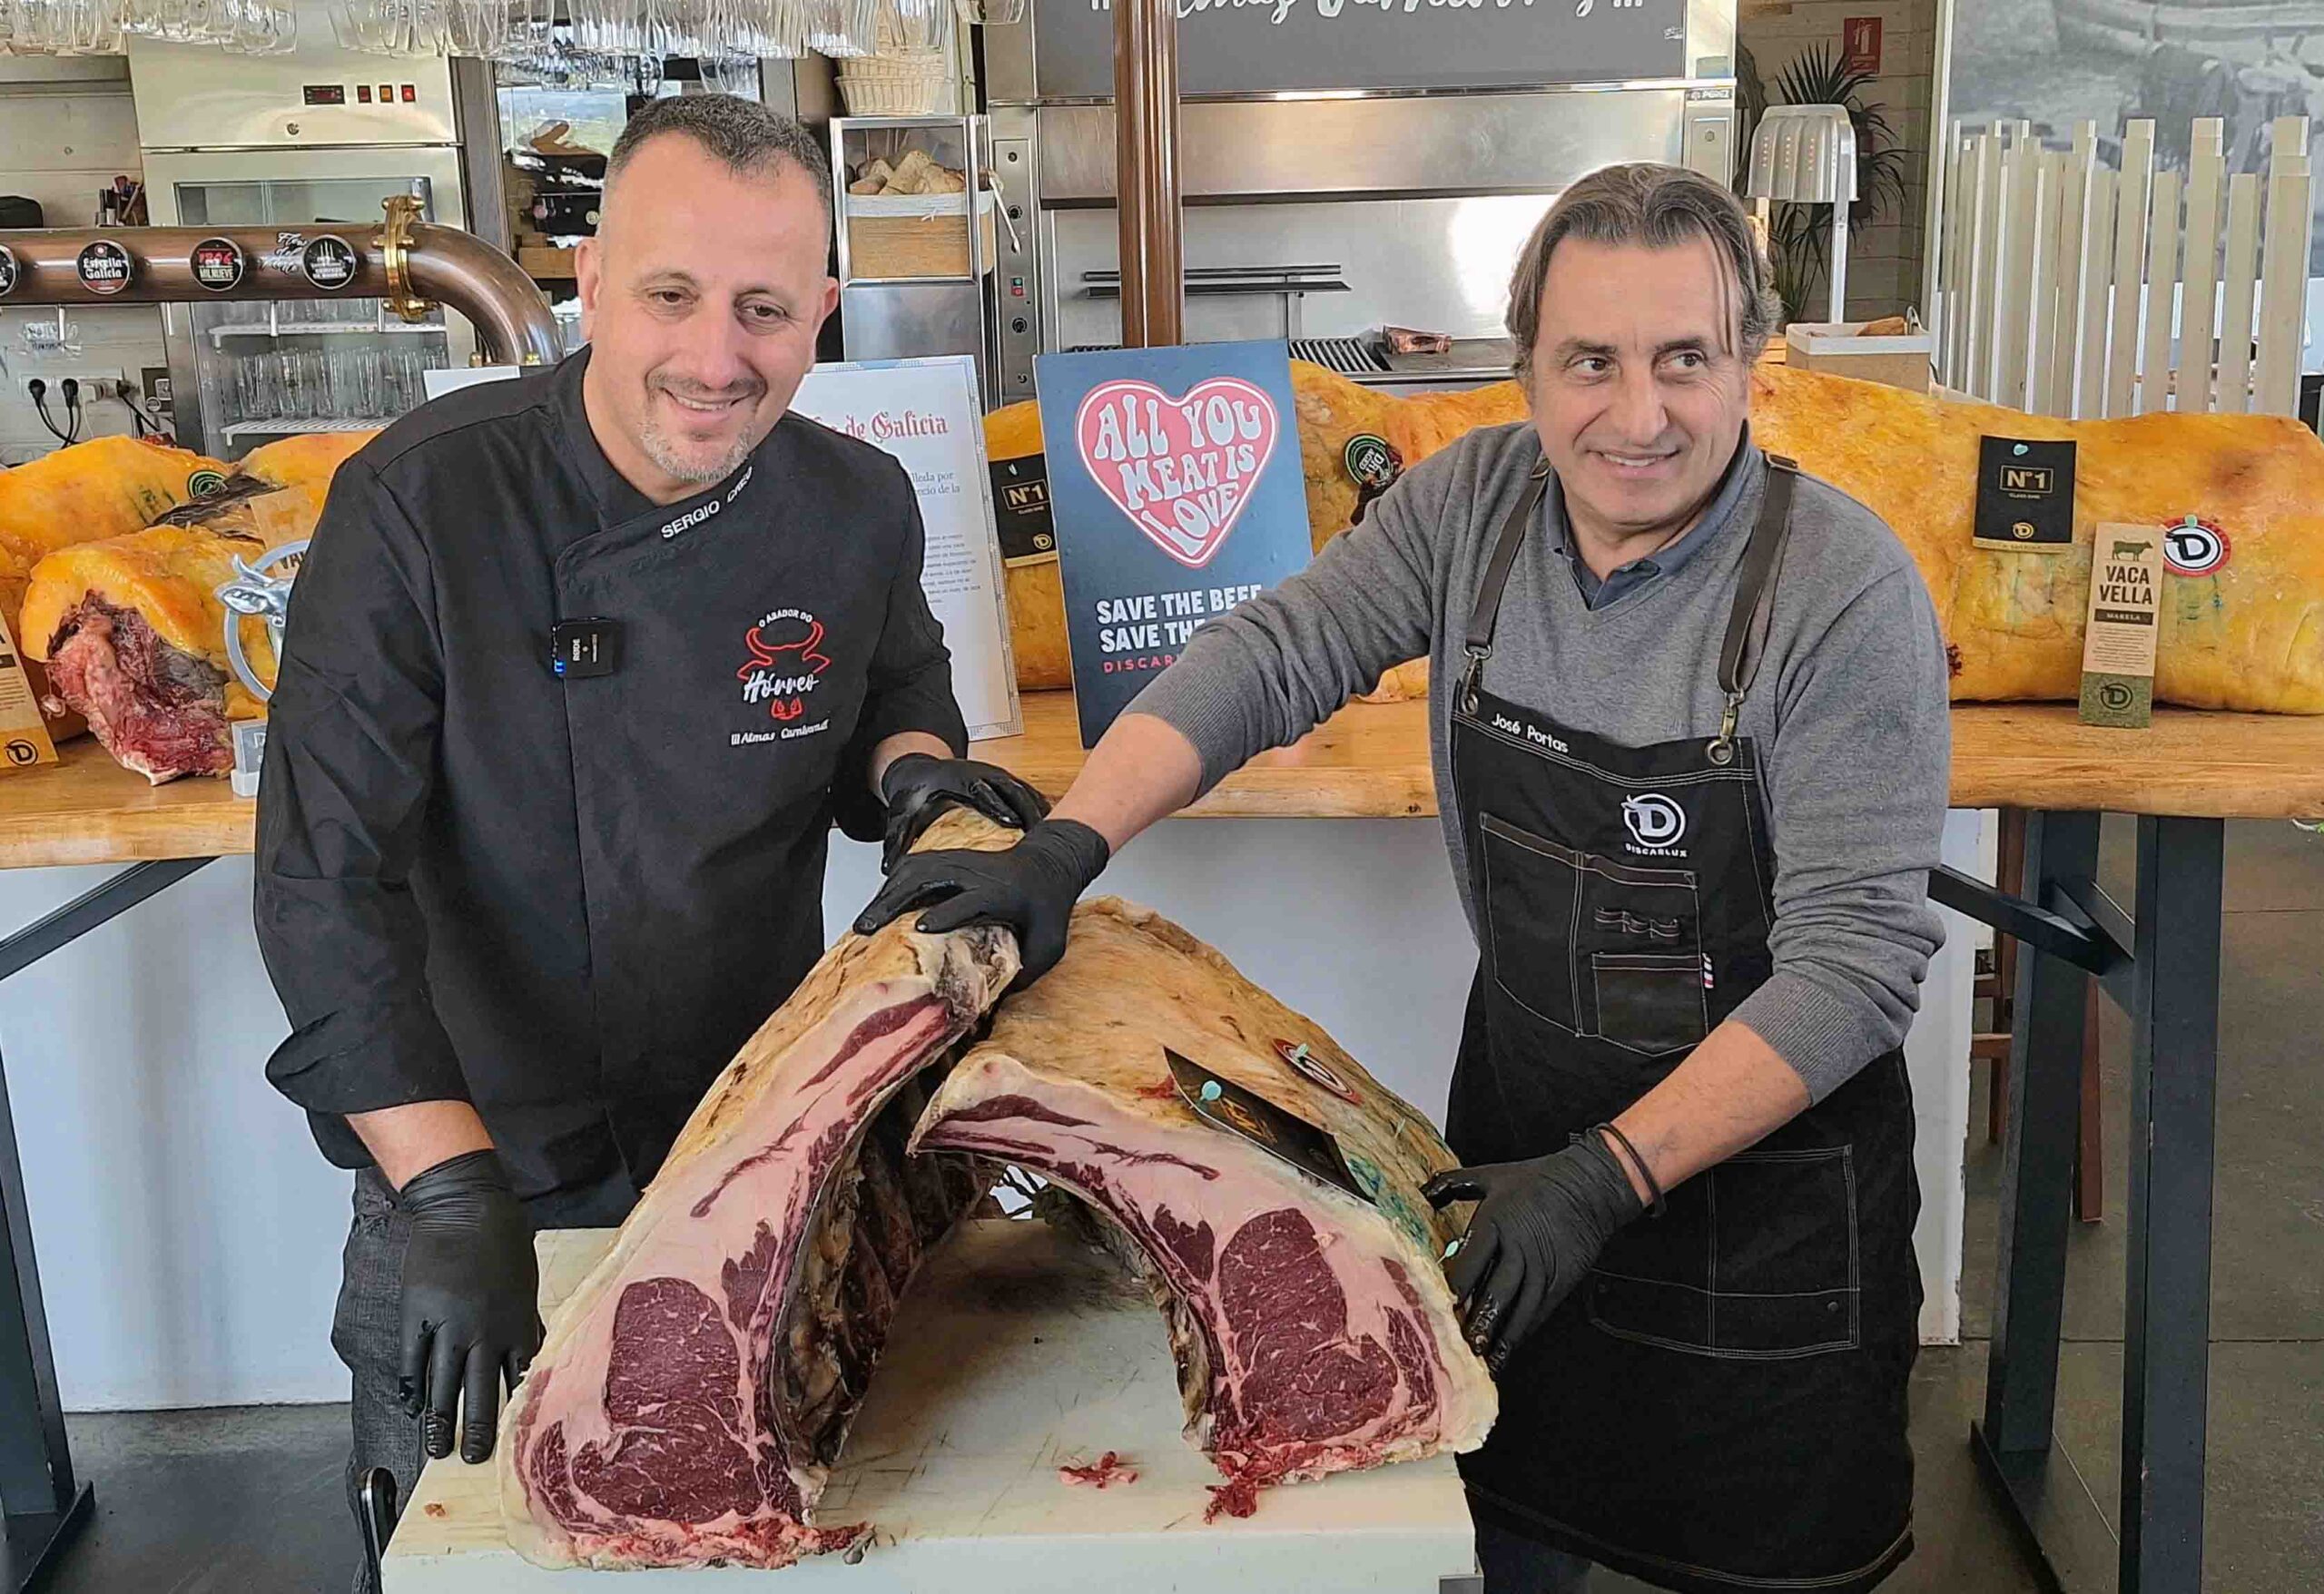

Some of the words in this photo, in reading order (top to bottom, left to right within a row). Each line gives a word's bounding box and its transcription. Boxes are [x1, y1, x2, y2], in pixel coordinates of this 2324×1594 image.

[84, 257, 123, 270] Estrella
[85, 268, 123, 280] Galicia
[871, 409, 949, 444] Galicia
[1094, 394, 1169, 461] ALL
[1182, 395, 1262, 448] YOU
[1118, 451, 1218, 510] MEAT
[1226, 444, 1256, 479] IS
[661, 500, 720, 538] SERGIO
[1140, 481, 1239, 556] LOVE
[2105, 565, 2150, 585] VACA
[1097, 595, 1157, 625] SAVE
[1161, 590, 1205, 617] THE
[1209, 584, 1263, 612] BEEF
[2099, 584, 2153, 605] VELLA
[758, 619, 766, 627] O
[800, 612, 813, 624] DO
[1100, 624, 1161, 653] SAVE
[1103, 654, 1179, 674] DISCAR
[743, 670, 820, 704] Hórreo
[1492, 713, 1521, 734] José
[1527, 724, 1569, 753] Portas
[1625, 843, 1688, 858] DISCARLUX
